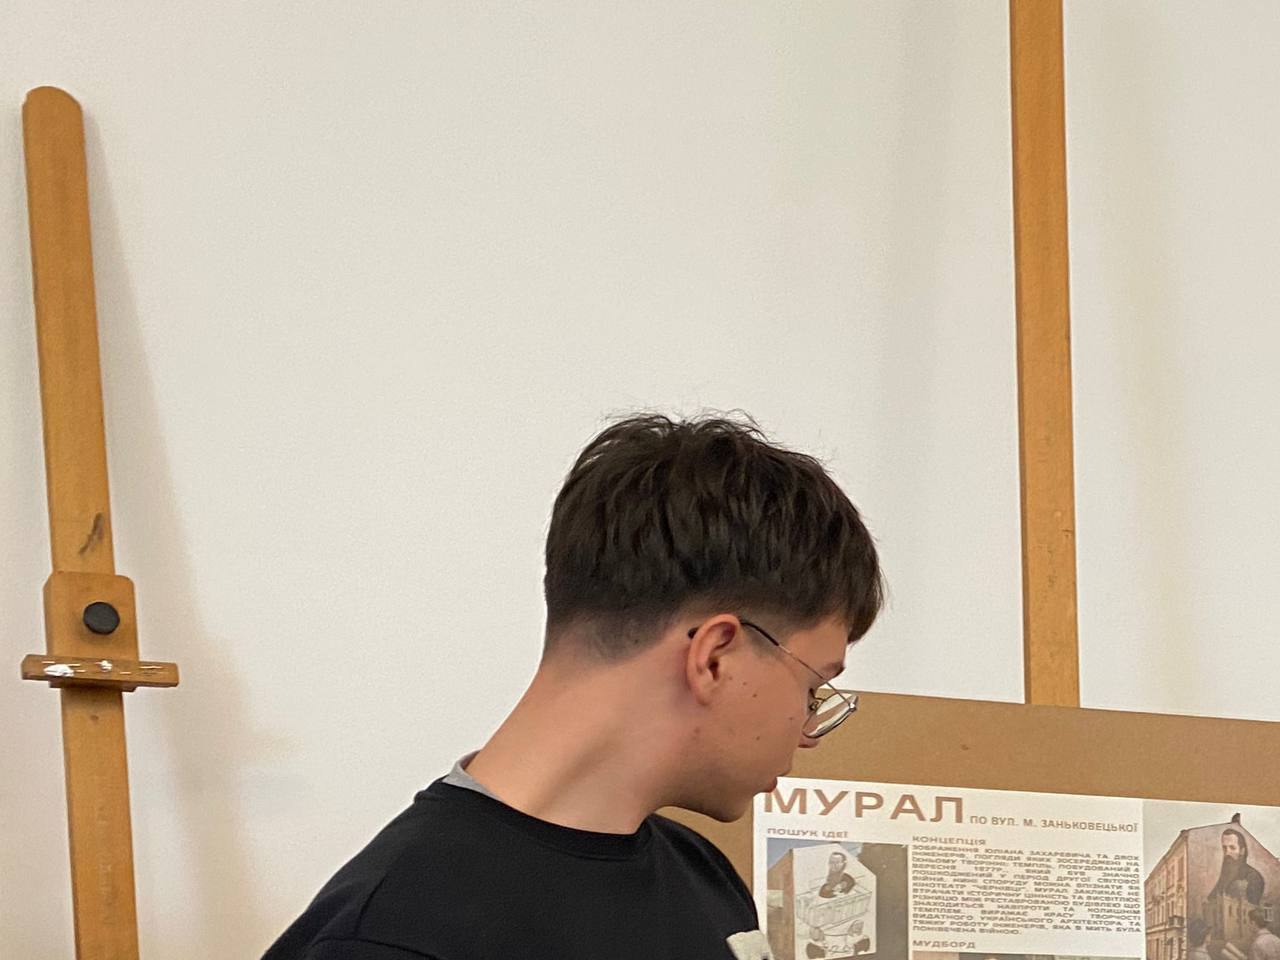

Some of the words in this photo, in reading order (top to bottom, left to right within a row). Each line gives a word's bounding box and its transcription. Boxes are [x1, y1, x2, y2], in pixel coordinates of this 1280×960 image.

[764, 787, 963, 824] МУРАЛ
[970, 816, 987, 825] ПО
[992, 816, 1020, 827] ВУЛ.
[1024, 818, 1038, 828] М.
[1041, 819, 1139, 833] ЗАНЬКОВЕЦЬКОЇ
[767, 828, 818, 837] ПОШУК
[912, 836, 986, 846] КОНЦЕПЦІЯ
[912, 939, 976, 949] МУДБОРД
